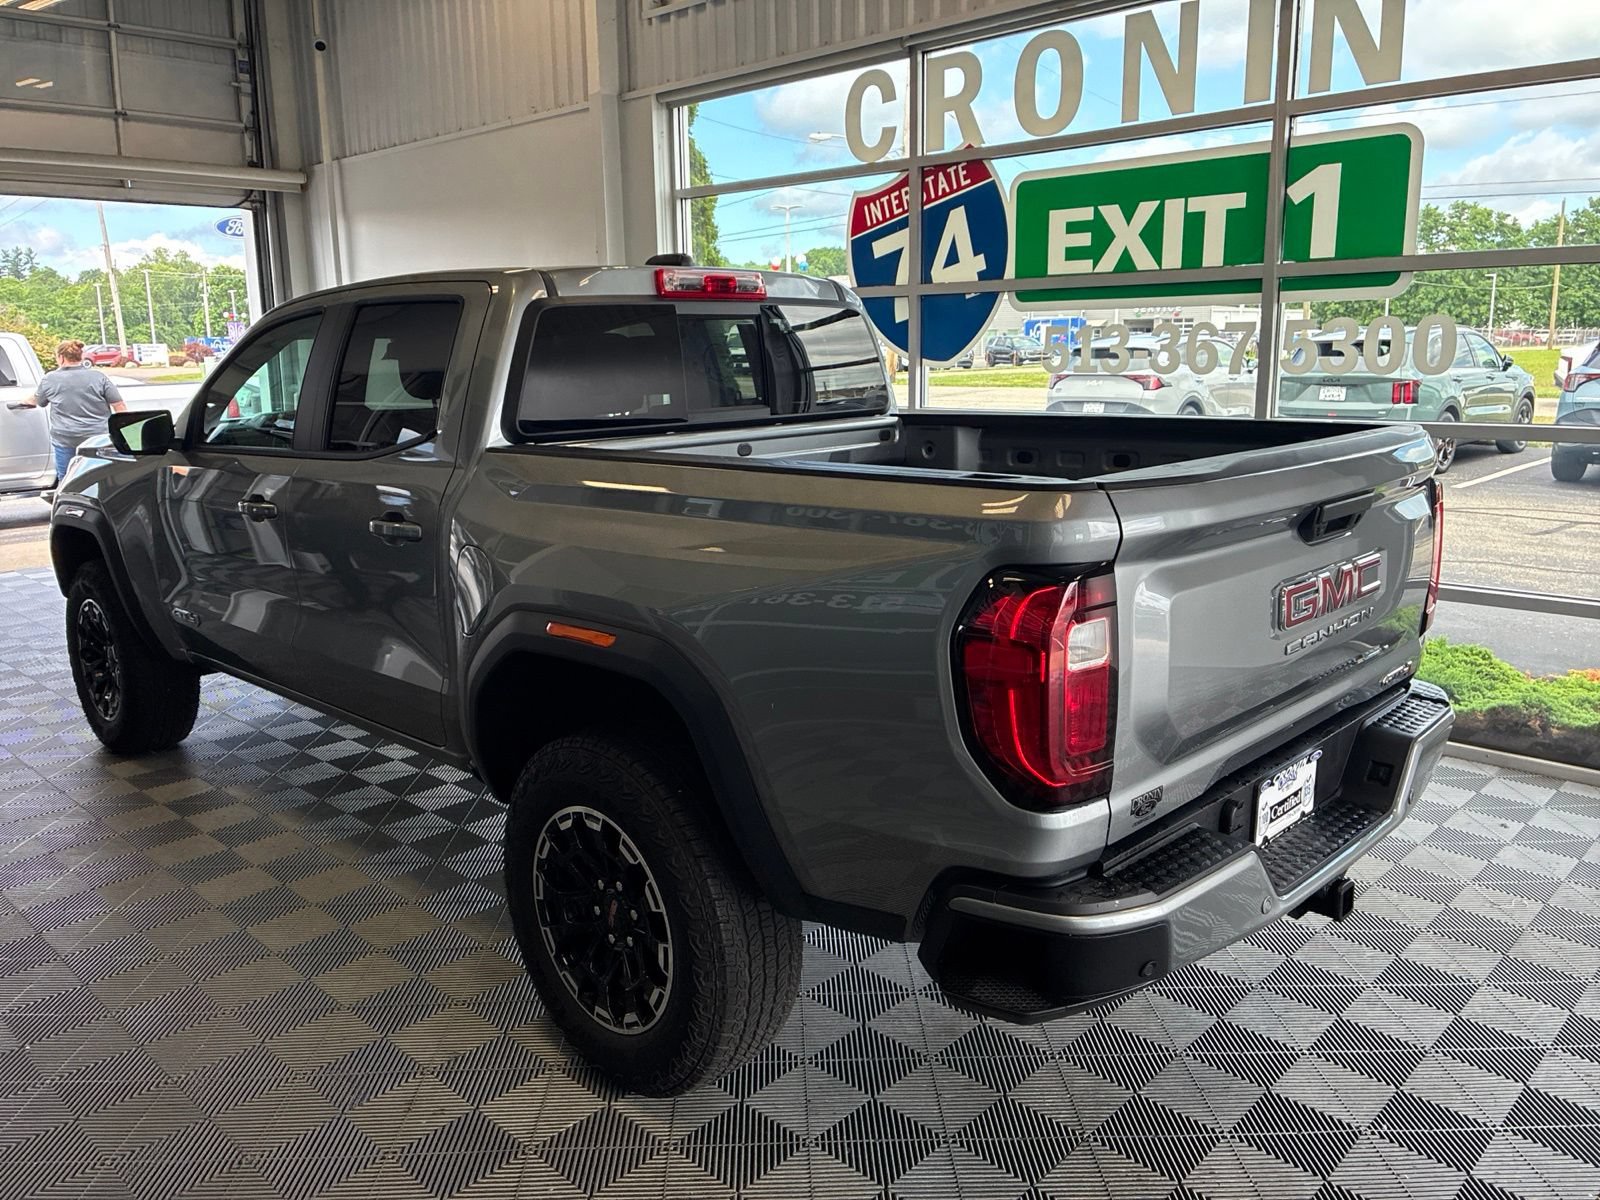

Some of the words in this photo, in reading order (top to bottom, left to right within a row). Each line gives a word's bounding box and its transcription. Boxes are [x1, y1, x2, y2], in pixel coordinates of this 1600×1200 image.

[845, 0, 1404, 163] CRONIN
[864, 162, 970, 227] INTERTATE
[1047, 192, 1247, 275] EXIT
[1286, 163, 1342, 260] 1
[871, 205, 987, 323] 74
[1042, 314, 1457, 376] 513-3675300
[1281, 552, 1382, 630] GMC
[1285, 606, 1375, 655] CANYON
